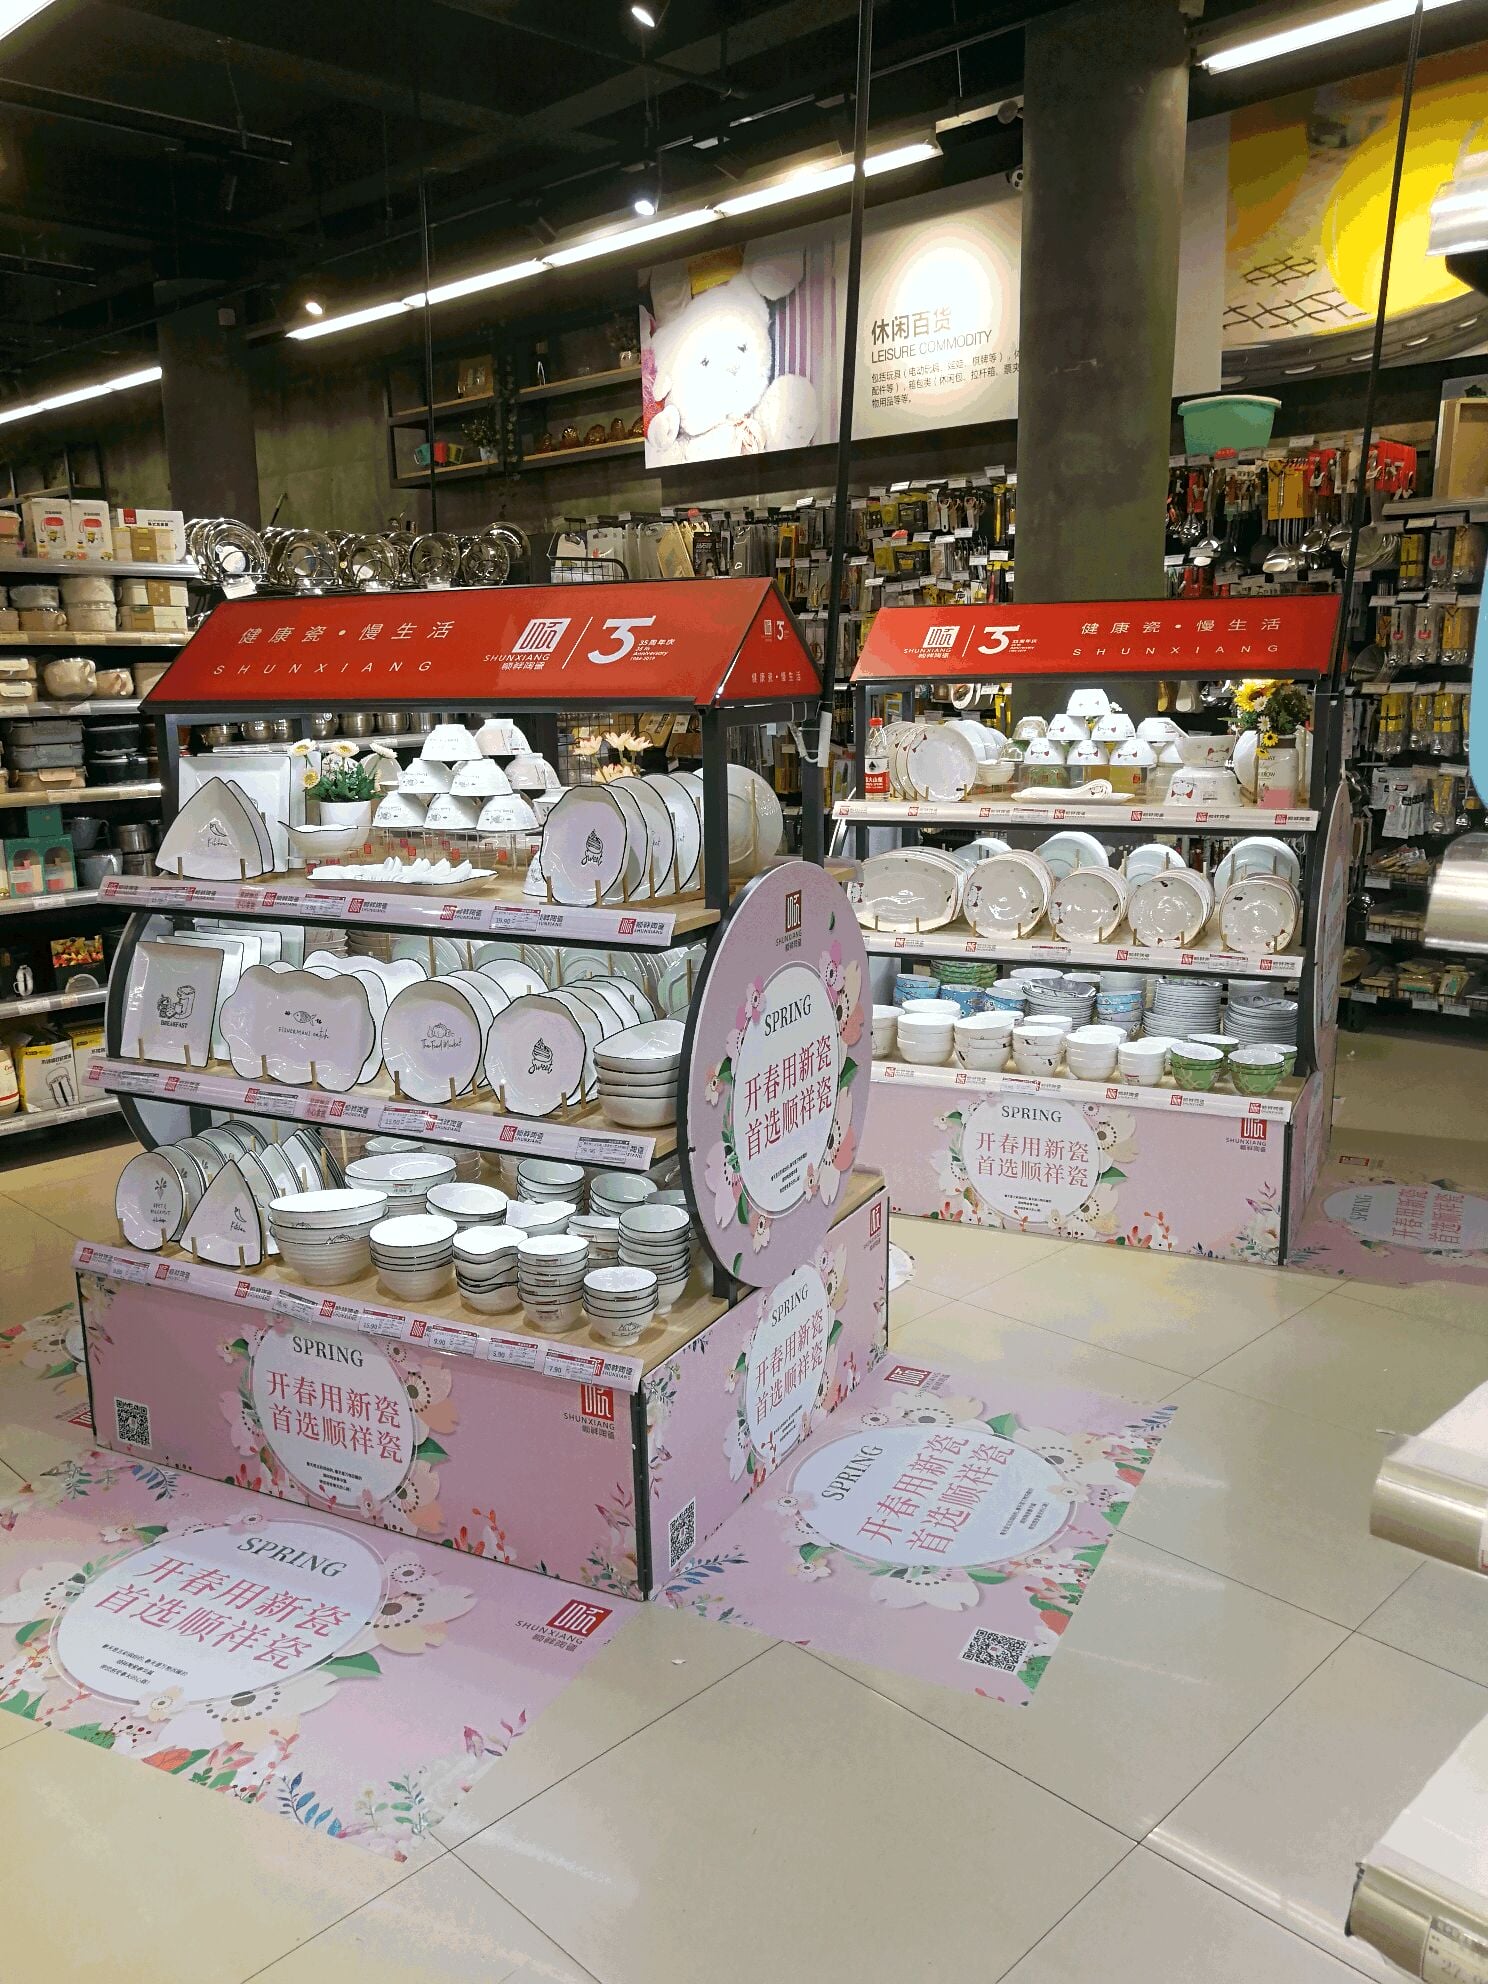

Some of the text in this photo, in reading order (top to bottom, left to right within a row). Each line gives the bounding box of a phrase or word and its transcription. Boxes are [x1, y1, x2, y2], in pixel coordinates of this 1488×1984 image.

[871, 306, 951, 345] 休闲百货
[871, 330, 992, 364] LEISURE COMMODITY
[213, 661, 433, 675] SHUNXIANG
[483, 654, 550, 662] SHUNXIANG
[1072, 645, 1278, 656] SHUNXIANG
[764, 994, 812, 1037] SPRING
[744, 1035, 832, 1117] 开春用新瓷
[745, 1076, 832, 1161] 首选顺祥瓷
[1001, 1105, 1062, 1123] SPRING
[976, 1131, 1088, 1163] 开春用新瓷
[1225, 1137, 1267, 1146] SHUNXIANG
[976, 1155, 1088, 1188] 首选顺祥瓷
[771, 1284, 809, 1327] SPRING
[293, 1336, 363, 1367] SPRING
[433, 1338, 446, 1346] 9.90
[756, 1308, 823, 1392] 开春用新瓷
[549, 1365, 562, 1373] 7.90
[755, 1340, 823, 1425] 首选顺祥瓷
[266, 1370, 400, 1429] 开春用新瓷
[268, 1403, 403, 1463] 首选顺祥瓷
[563, 1413, 615, 1430] SHUNXIANG
[821, 1445, 883, 1500] SPRING
[856, 1434, 970, 1545] 开春用新瓷
[906, 1443, 1015, 1553] 首选顺祥瓷
[236, 1537, 348, 1578] SPRING
[133, 1555, 351, 1637] 开春用新瓷
[94, 1583, 312, 1669] 首选顺祥瓷
[515, 1620, 583, 1645] SHUNXIANG
